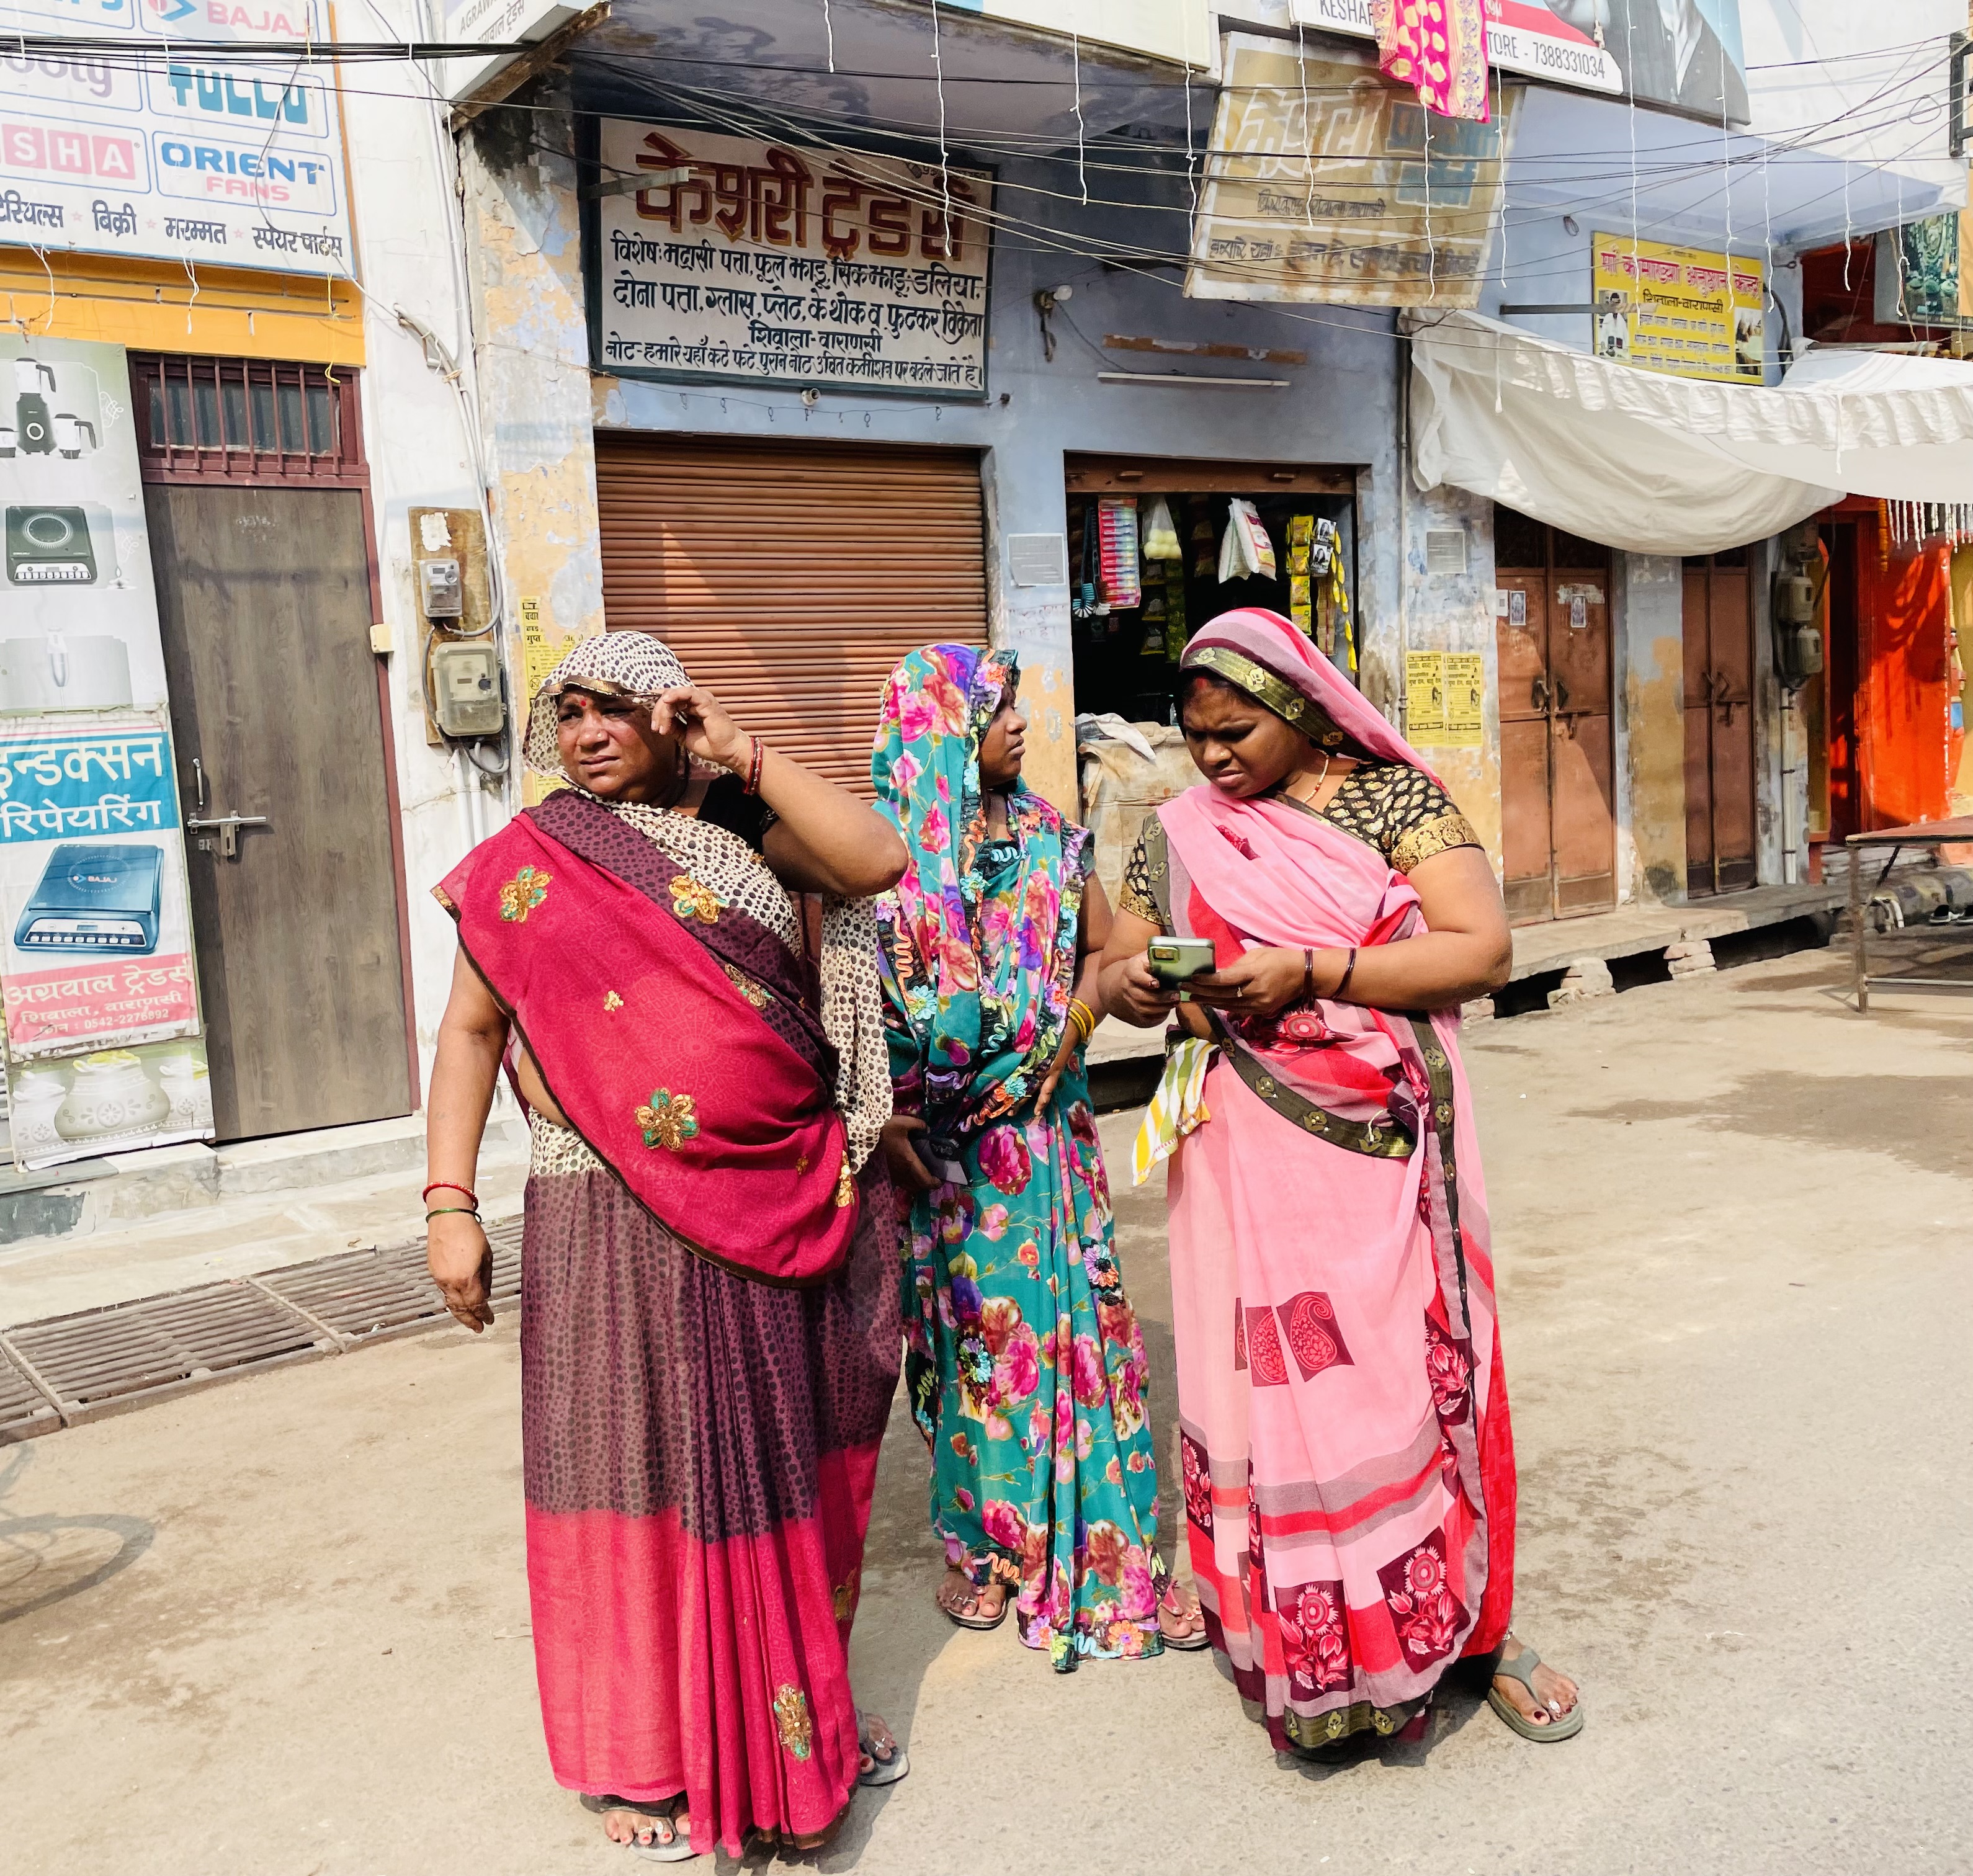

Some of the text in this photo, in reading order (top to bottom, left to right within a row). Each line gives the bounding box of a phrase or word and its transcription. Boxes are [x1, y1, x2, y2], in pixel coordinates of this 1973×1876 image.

[1487, 31, 1519, 59] TORE
[1532, 42, 1606, 79] 7388331034
[168, 64, 308, 125] TULLU
[161, 141, 326, 185] ORIENT
[206, 176, 290, 202] FANS
[635, 132, 814, 248] केशरी
[92, 199, 137, 237] बिक्री
[164, 217, 227, 244] मरम्मत
[754, 253, 788, 284] फूल
[613, 270, 658, 309] दोना
[808, 288, 828, 322] के
[829, 290, 867, 325] थोक
[868, 303, 884, 328] व
[884, 303, 941, 339] फुटकर
[941, 299, 985, 345] विक्रेता
[643, 336, 682, 366] हमारे
[708, 340, 730, 368] कटे
[732, 344, 757, 370] फटे
[789, 347, 814, 374] नोट
[88, 875, 117, 883] BAJAJ
[4, 975, 117, 1006] अग्रवाल
[104, 990, 184, 1012] वाराणसी
